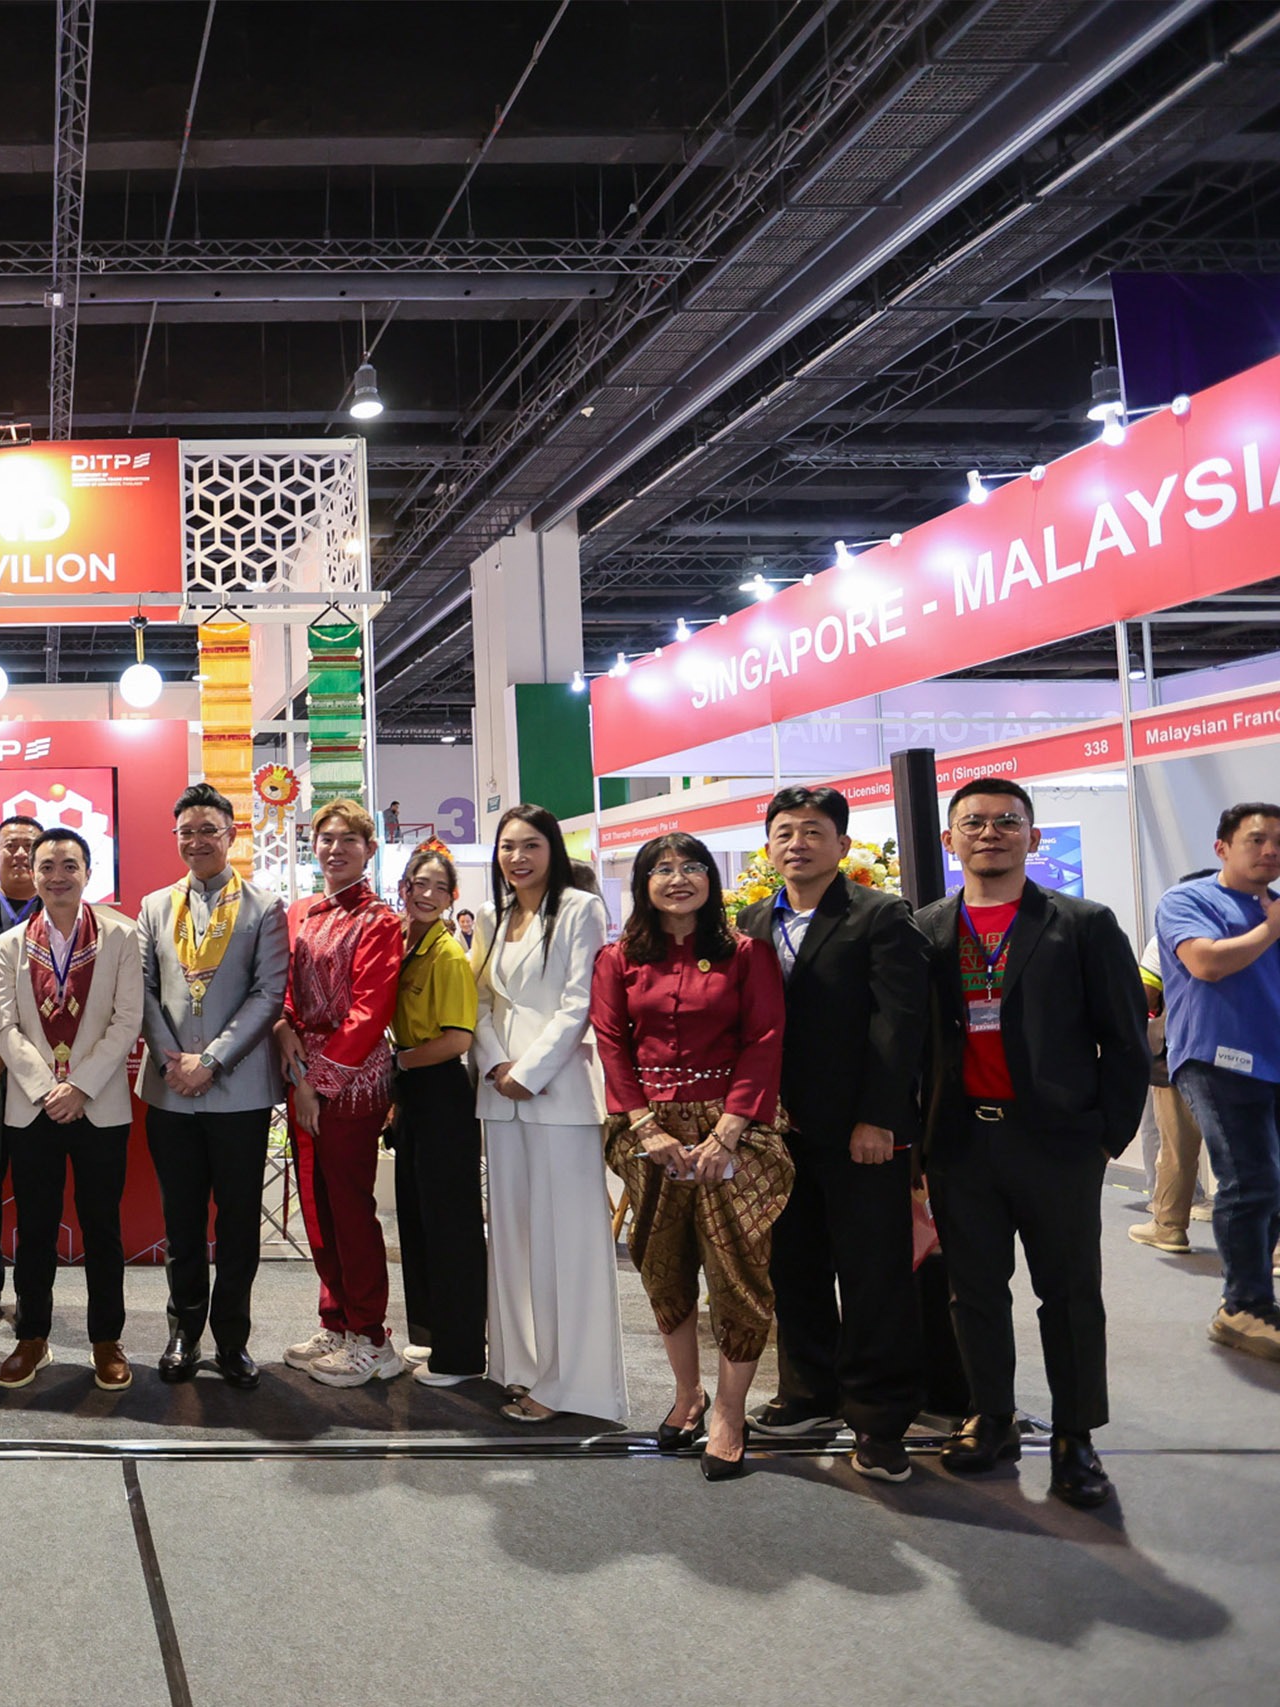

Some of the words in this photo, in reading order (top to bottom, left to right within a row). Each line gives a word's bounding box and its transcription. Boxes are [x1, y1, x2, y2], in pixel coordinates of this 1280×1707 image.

[71, 454, 131, 471] DITP
[691, 587, 906, 709] SINGAPORE
[1145, 719, 1228, 745] Malaysian
[952, 757, 1017, 786] (Singapore)
[1083, 739, 1109, 757] 338
[848, 783, 890, 799] Licensing
[437, 797, 476, 844] 3
